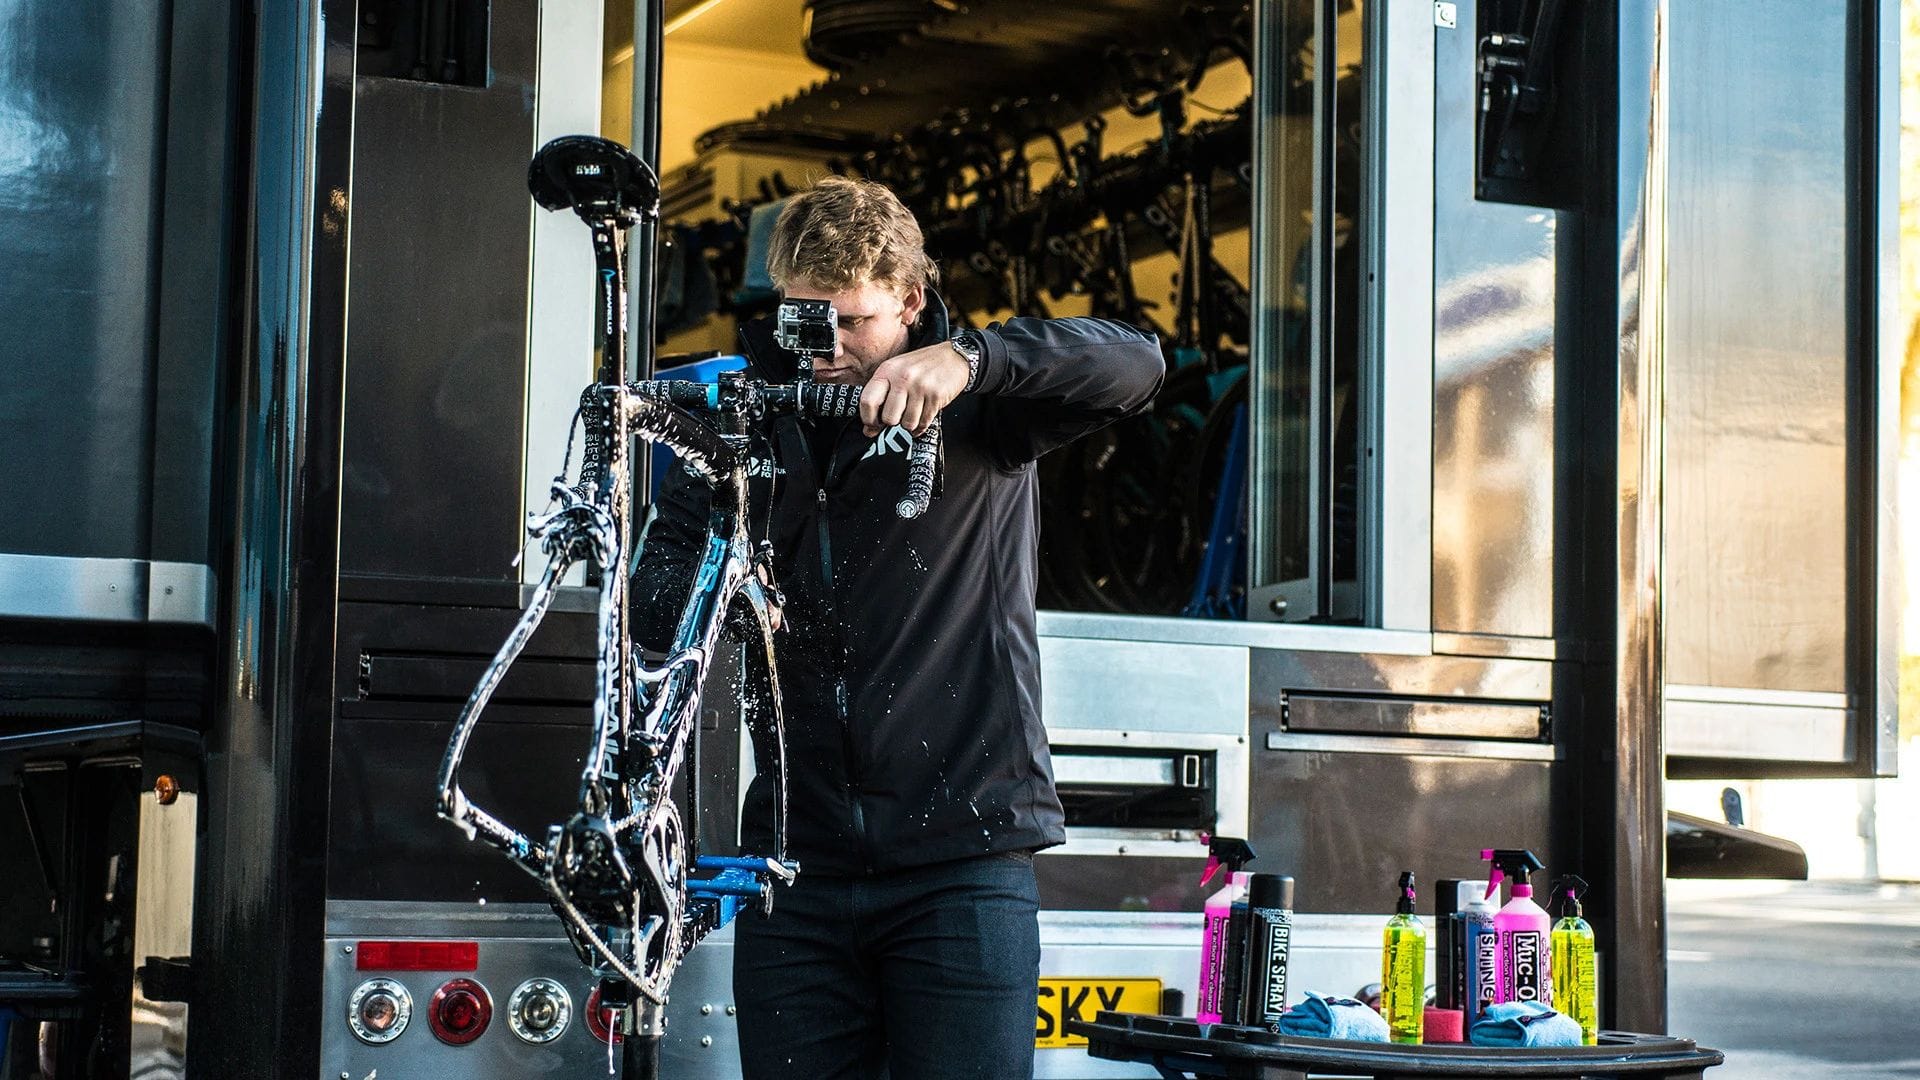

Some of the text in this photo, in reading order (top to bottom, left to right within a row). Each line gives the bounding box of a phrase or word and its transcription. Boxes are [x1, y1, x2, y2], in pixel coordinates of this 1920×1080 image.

[1209, 962, 1217, 980] bike
[1269, 927, 1289, 1012] BIKE SPRAY
[1517, 936, 1537, 1001] Muc-O
[1207, 981, 1215, 1012] cleaner
[1503, 976, 1511, 994] bike
